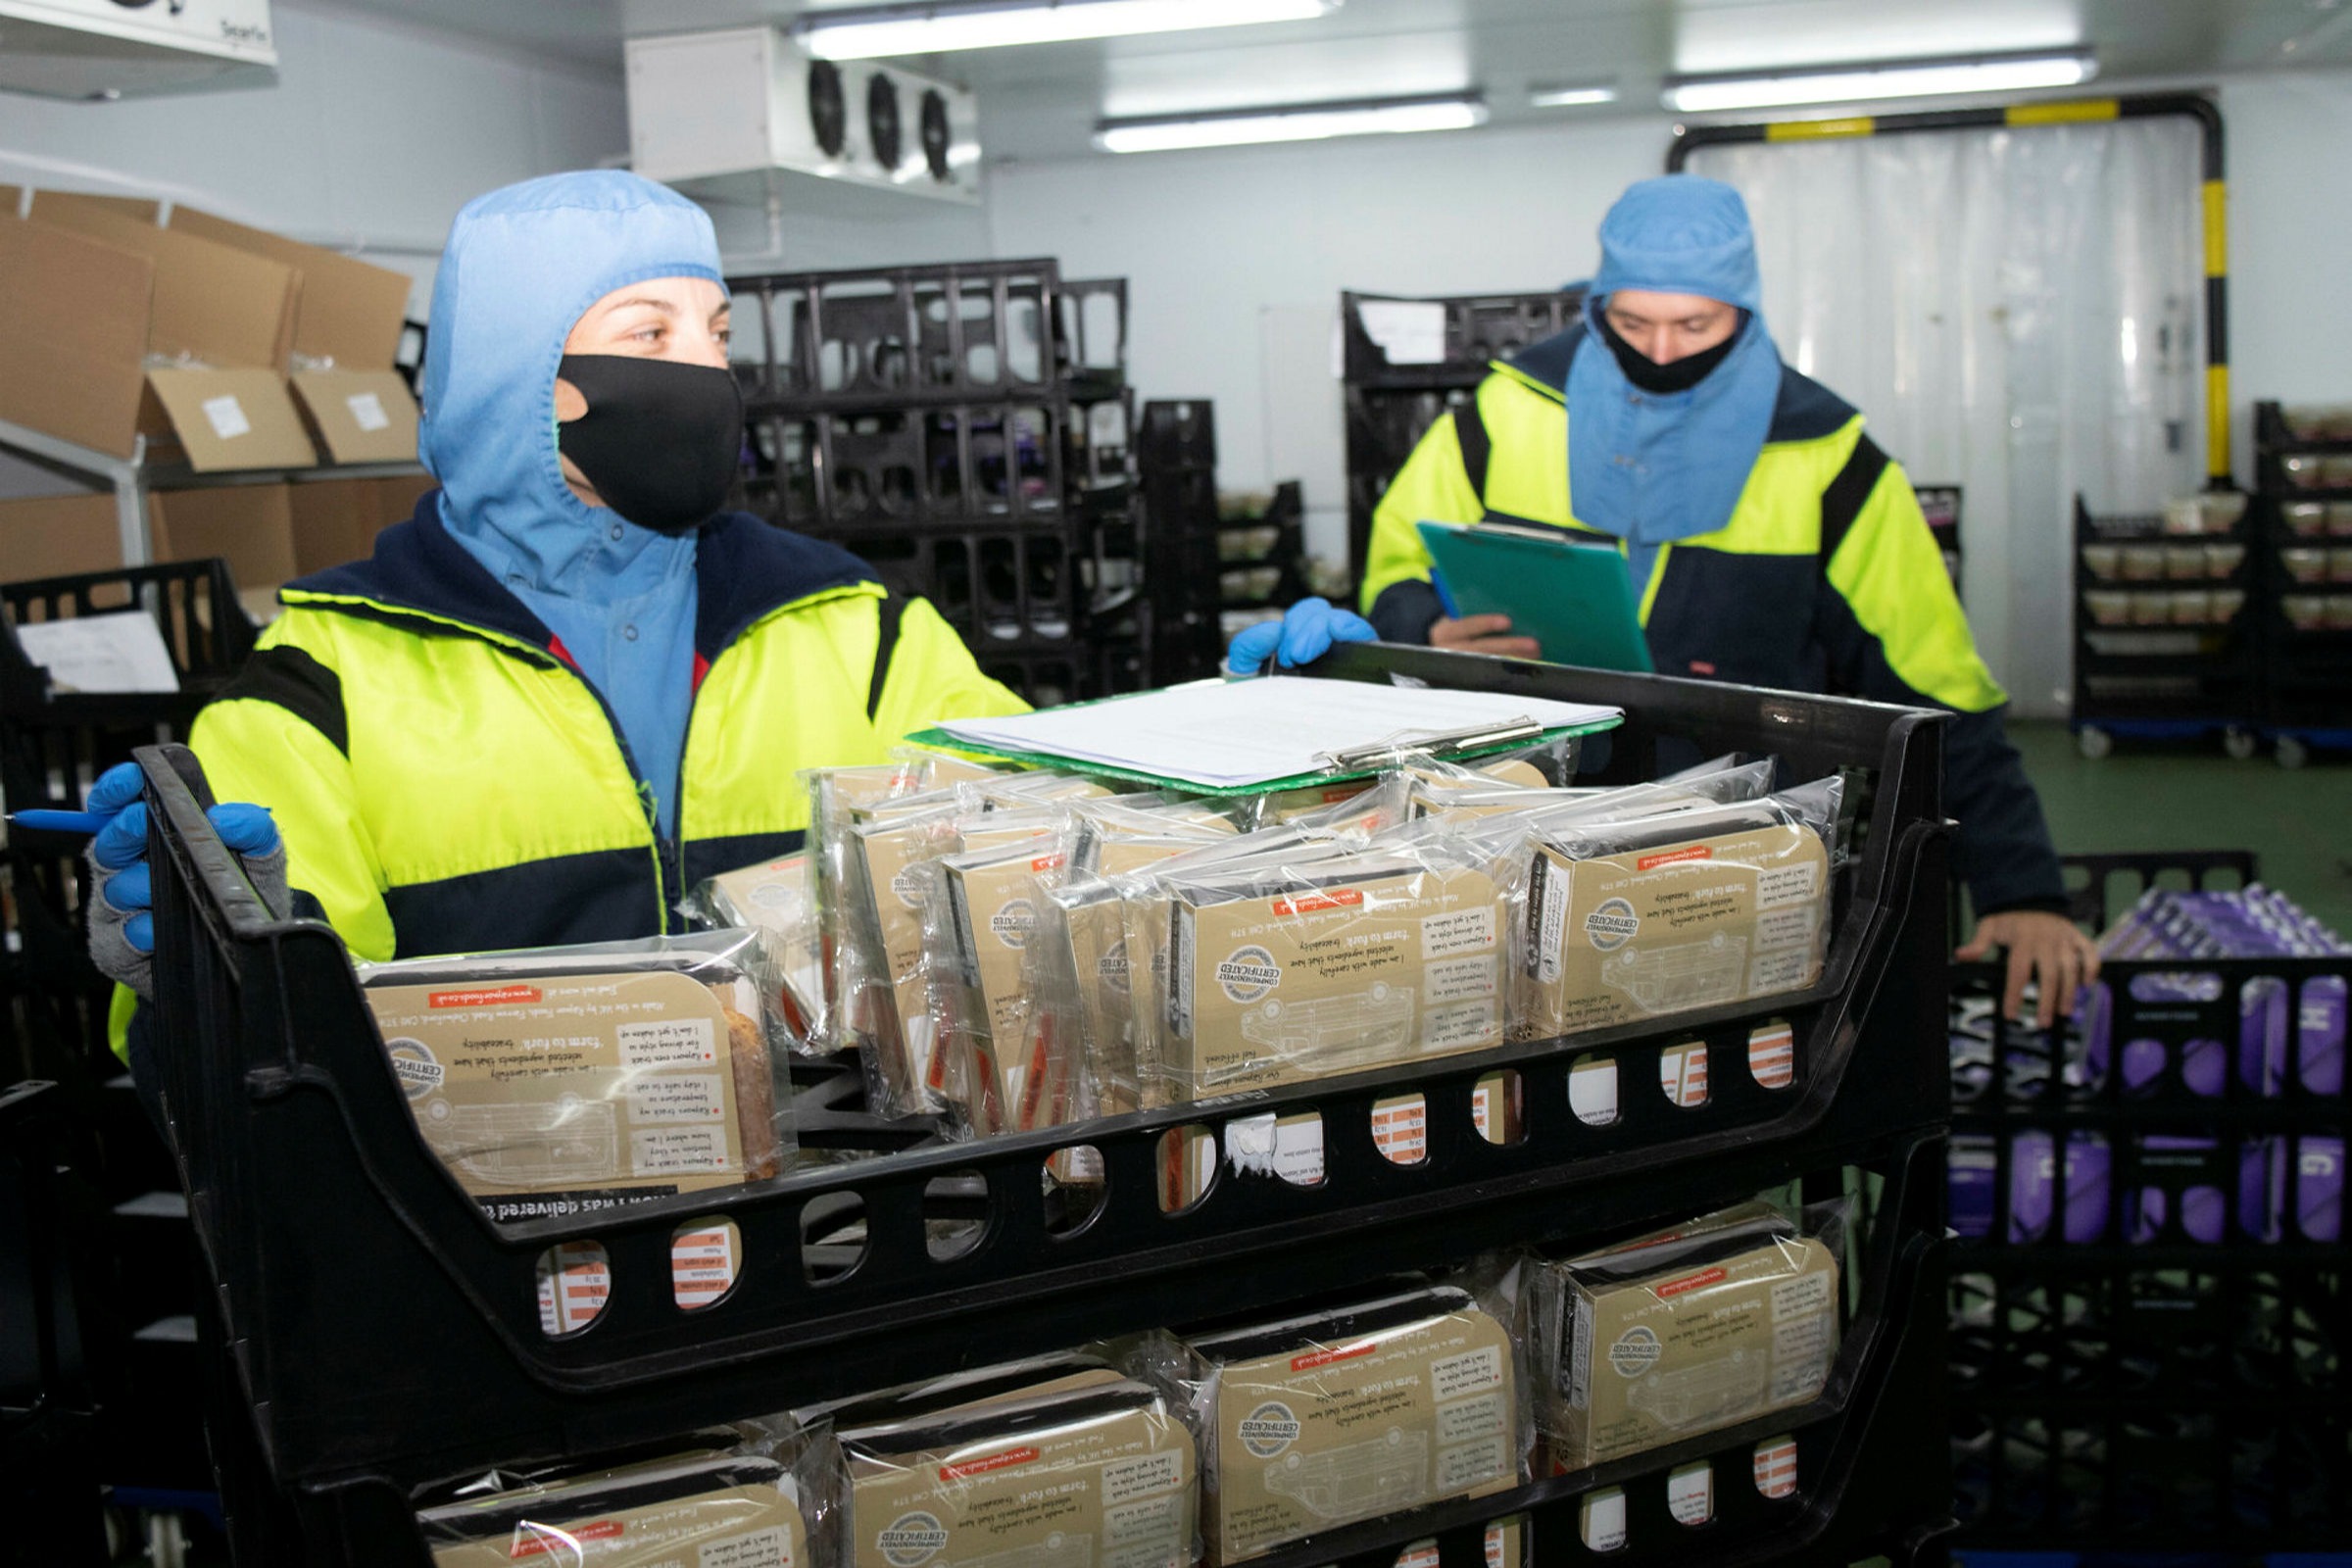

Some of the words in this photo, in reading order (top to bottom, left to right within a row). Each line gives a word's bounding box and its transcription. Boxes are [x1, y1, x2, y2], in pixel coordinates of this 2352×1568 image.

[1589, 915, 1637, 926] CERTIFICATED
[1369, 933, 1380, 944] to
[1326, 947, 1364, 963] ingredients
[1366, 945, 1395, 957] selected
[1289, 958, 1306, 970] have
[1307, 956, 1324, 967] that
[1351, 961, 1367, 972] with
[1370, 957, 1388, 969] made
[1220, 964, 1278, 976] CERTIFICATED
[1318, 962, 1350, 979] carefully
[1218, 973, 1277, 984] COMPREHENSIVELY
[548, 988, 557, 997] at
[560, 987, 578, 996] more
[582, 986, 598, 995] out
[600, 985, 615, 995] Find
[437, 988, 532, 1005] www.raynorfoods.co.uk
[632, 1030, 654, 1039] shaken
[658, 1026, 670, 1037] get
[672, 1027, 691, 1036] don't
[552, 1038, 564, 1050] to
[639, 1041, 657, 1052] style
[659, 1039, 683, 1049] driving
[686, 1041, 699, 1050] for
[499, 1051, 543, 1065] ingredients
[548, 1053, 582, 1062] selected
[1242, 1050, 1256, 1059] fuel
[454, 1058, 471, 1067] have
[474, 1056, 494, 1066] that
[490, 1064, 527, 1082] carefully
[531, 1067, 549, 1077] with
[553, 1065, 573, 1076] made
[664, 1083, 680, 1093] safe
[684, 1079, 700, 1089] stay
[661, 1092, 708, 1103] temperature
[654, 1108, 674, 1117] track
[497, 1200, 578, 1220] delivered
[581, 1198, 614, 1211] was
[1045, 1486, 1057, 1497] to
[988, 1516, 1023, 1534] carefully
[881, 1532, 945, 1541] CERTIFICATED
[881, 1539, 943, 1547] COMPREHENSIVELY
